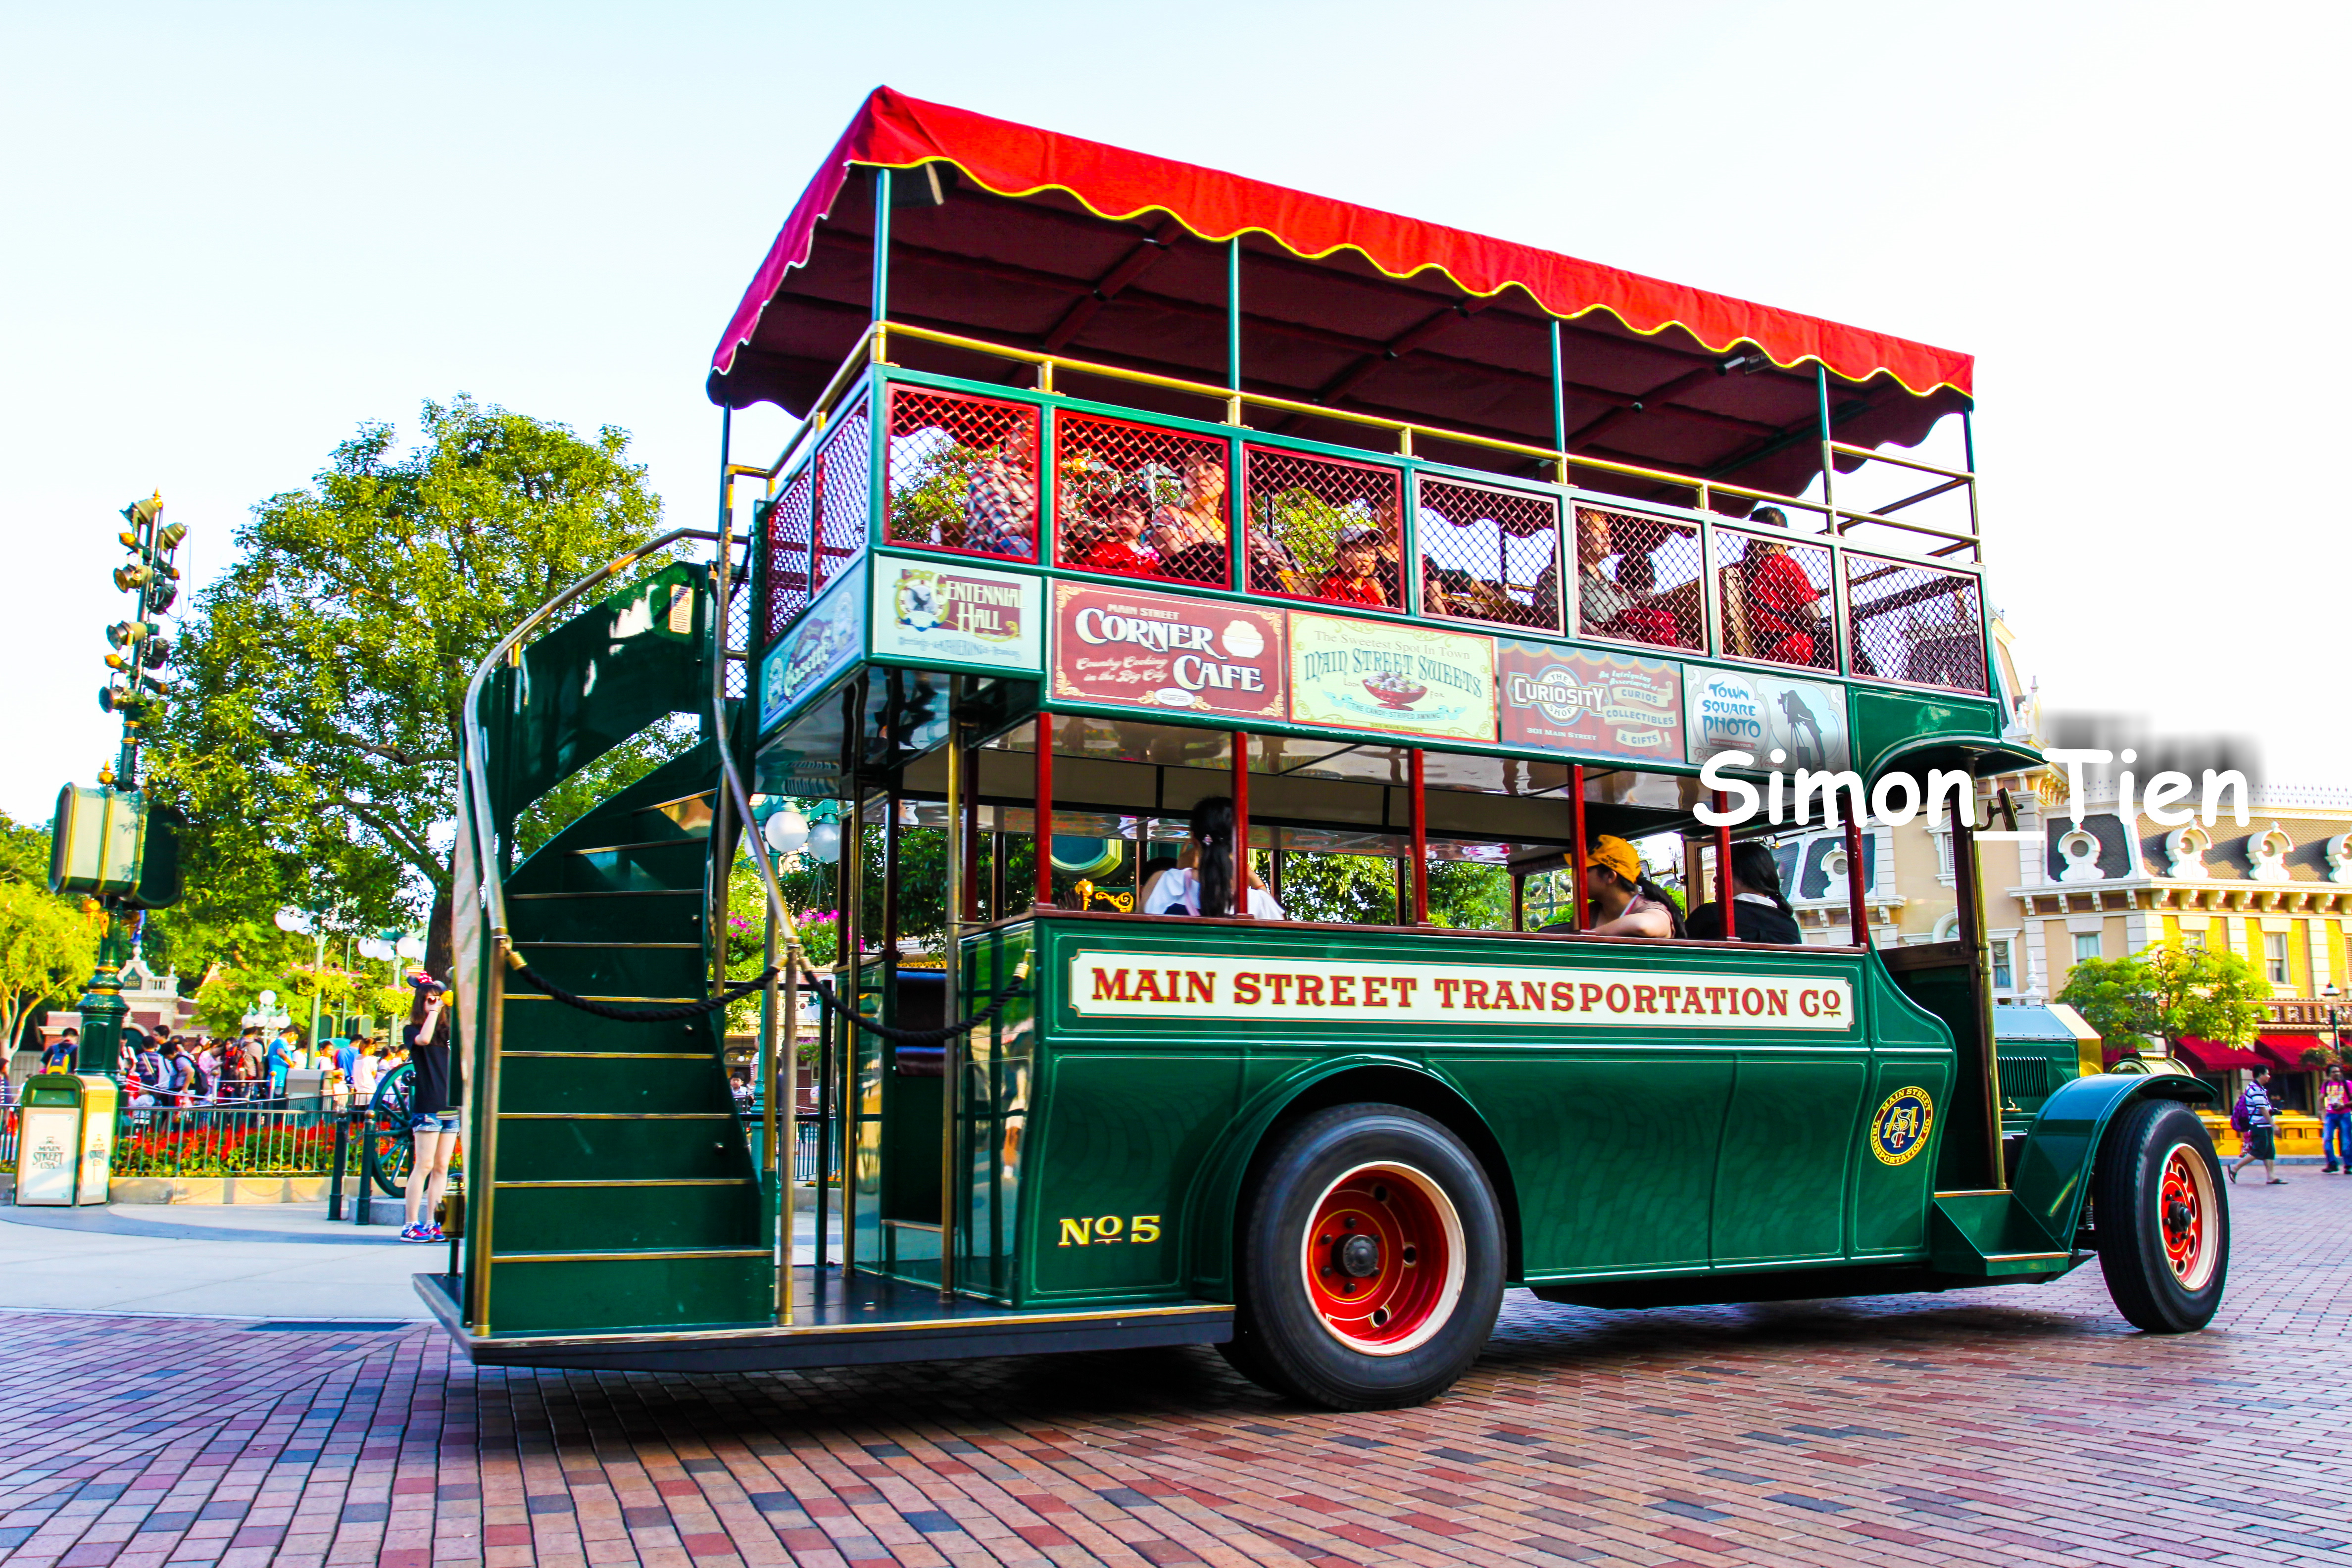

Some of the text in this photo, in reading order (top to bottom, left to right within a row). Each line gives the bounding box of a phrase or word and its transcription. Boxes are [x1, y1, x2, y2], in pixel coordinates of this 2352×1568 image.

[931, 573, 1027, 609] CENTENNIAL
[957, 602, 1003, 636] HALL
[1107, 604, 1180, 620] MAIN STREET
[1075, 607, 1228, 660] CORNER
[1314, 631, 1470, 660] The Sweetest Spot In Town
[1076, 655, 1169, 671] Country Cooking
[1304, 648, 1482, 698] MAIN STREET SWEETS
[1098, 670, 1116, 681] the
[1116, 670, 1142, 684] Big
[1142, 669, 1169, 683] City
[1173, 655, 1265, 692] CAFE
[1551, 674, 1568, 683] THE
[1612, 670, 1652, 683] Intriguing
[1514, 678, 1605, 712] CURIOSITY
[1621, 688, 1658, 703] CURIOS
[1709, 681, 1749, 701] TOWN
[1548, 705, 1573, 717] SHOP
[1606, 709, 1674, 725] COLLECTIBLES
[1702, 699, 1757, 717] SQUARE
[1568, 732, 1597, 740] STREET
[1620, 733, 1658, 744] & GIFTS
[1701, 715, 1761, 744] PHOTO
[1091, 968, 1216, 1003] MAIN
[1233, 971, 1418, 1008] STREET
[1433, 977, 1789, 1016] TRANSPORTATION
[1882, 1088, 1931, 1111] MAIN STREET
[1872, 1120, 1924, 1163] TRANSPORTATION
[32, 1152, 64, 1166] STREET
[1130, 1214, 1161, 1245] 5
